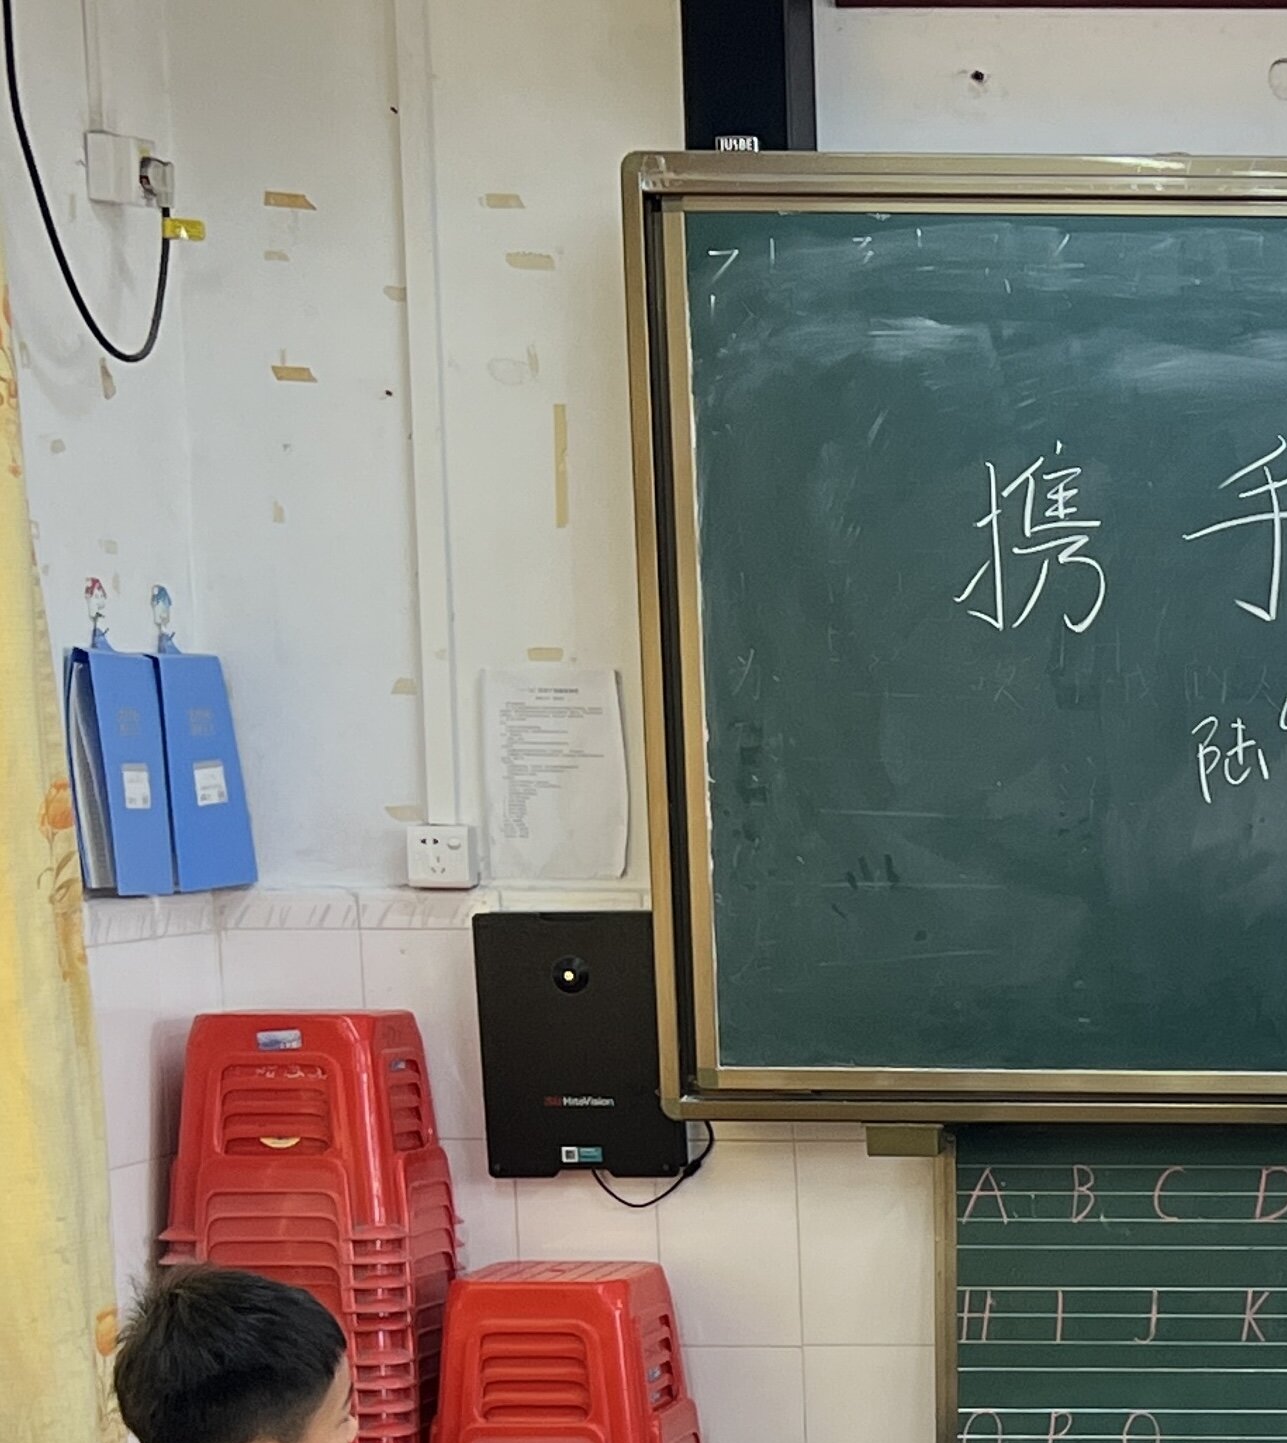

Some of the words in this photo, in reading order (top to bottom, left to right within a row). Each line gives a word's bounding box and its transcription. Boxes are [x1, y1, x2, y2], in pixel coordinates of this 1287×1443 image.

[963, 1168, 1008, 1224] A
[1072, 1165, 1095, 1223] B
[1153, 1167, 1185, 1221] C
[960, 1289, 993, 1343] H
[1135, 1289, 1158, 1344] J
[1241, 1291, 1270, 1343] K
